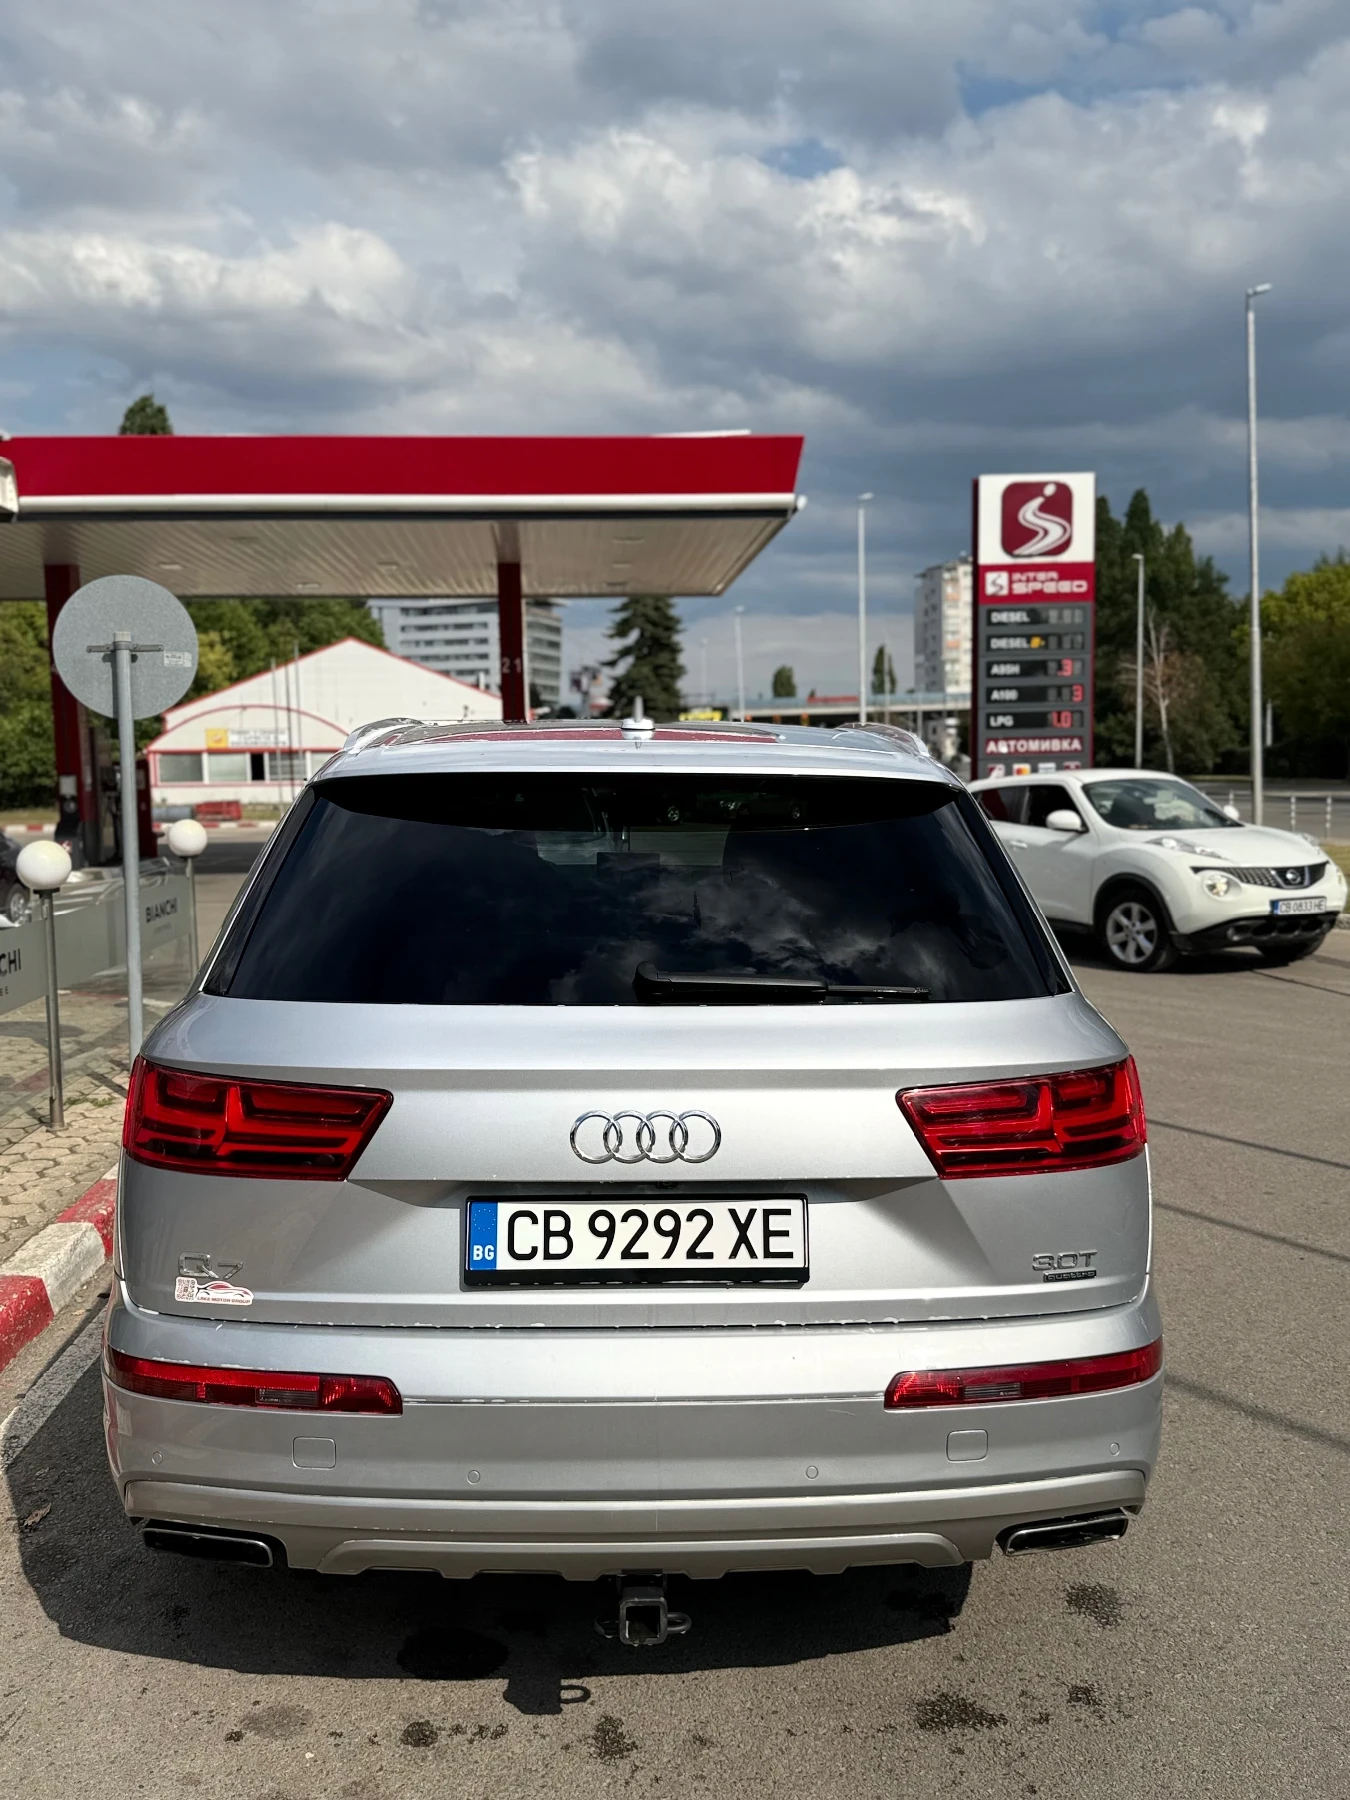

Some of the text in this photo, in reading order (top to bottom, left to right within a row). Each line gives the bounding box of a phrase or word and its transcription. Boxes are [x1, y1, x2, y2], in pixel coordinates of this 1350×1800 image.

[1011, 572, 1058, 581] INTER
[1011, 580, 1088, 595] SPEED
[990, 610, 1030, 623] DIESEL
[990, 637, 1029, 649] DIESEL
[989, 715, 1014, 727] LPG
[145, 897, 178, 923] BIANCHI
[472, 1208, 794, 1261] BG CB 9292 XE
[1047, 1271, 1096, 1280] quattro
